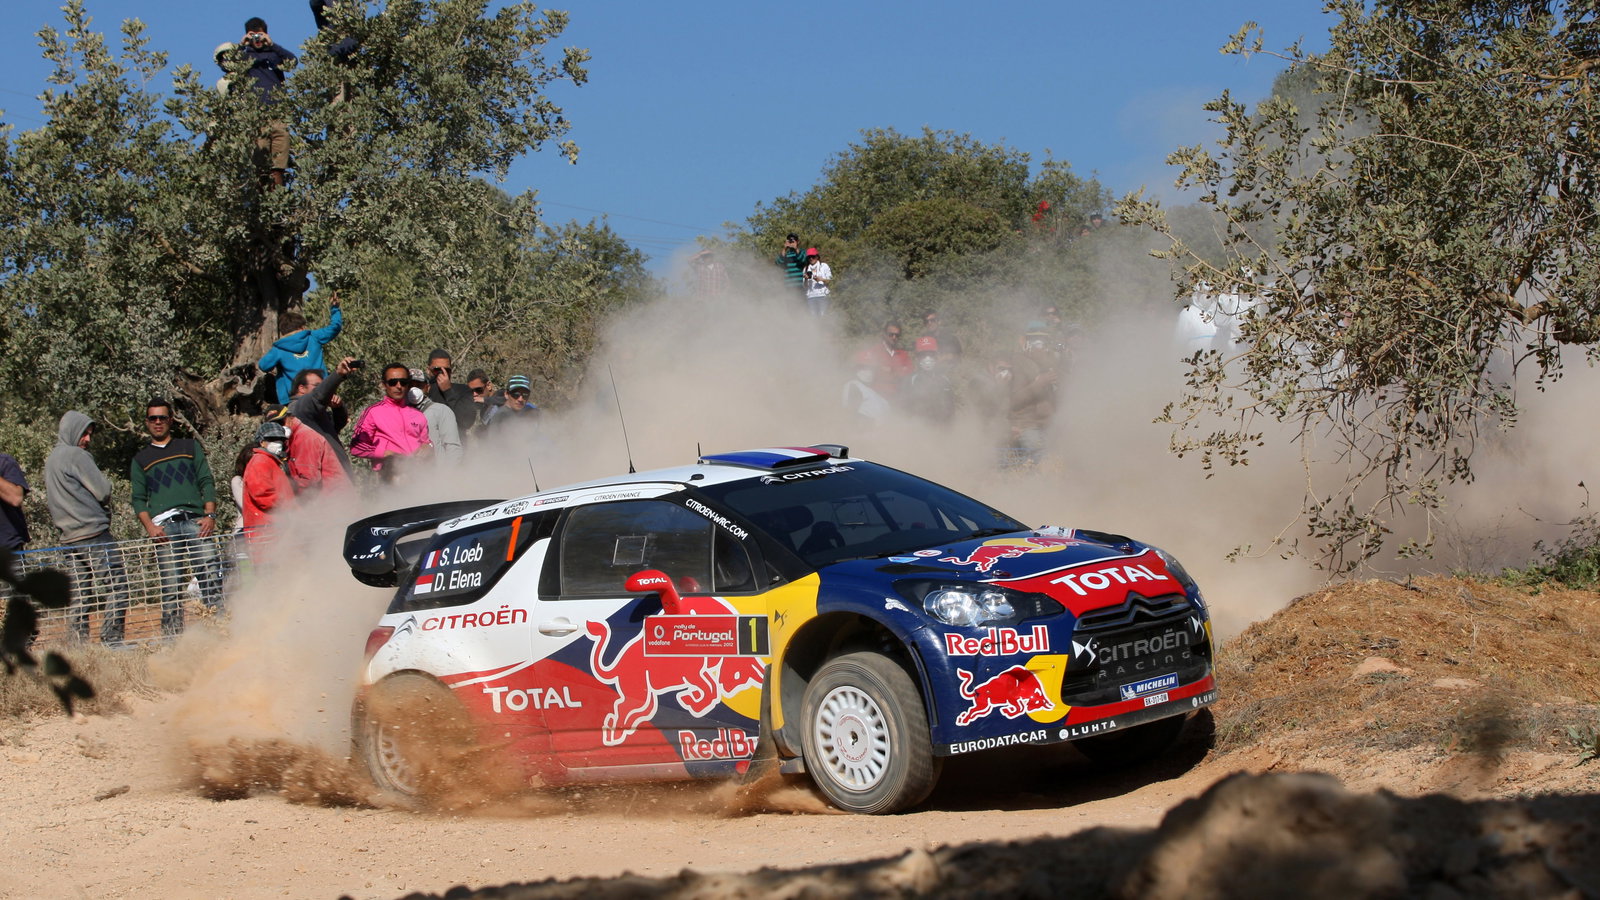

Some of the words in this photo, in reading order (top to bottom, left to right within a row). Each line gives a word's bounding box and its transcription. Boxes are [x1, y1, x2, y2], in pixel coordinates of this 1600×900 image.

[685, 498, 748, 540] CITROEN-WRC.COM
[505, 516, 523, 561] 1
[439, 547, 450, 567] S.
[453, 542, 484, 564] Loeb
[434, 572, 446, 592] D.
[449, 570, 482, 590] Elena
[637, 577, 668, 586] TOTAL
[1049, 564, 1169, 596] TOTAL
[421, 604, 528, 632] CITROËN
[673, 630, 734, 643] Portugal
[748, 617, 757, 653] 1
[944, 627, 998, 657] Red
[998, 625, 1050, 656] Bull
[1099, 628, 1189, 664] CITROËN
[1136, 676, 1176, 693] MICHELIN
[482, 685, 583, 714] TOTAL
[950, 729, 1047, 755] EURODATACAR
[1072, 720, 1117, 737] LUHTA
[678, 728, 730, 760] Red
